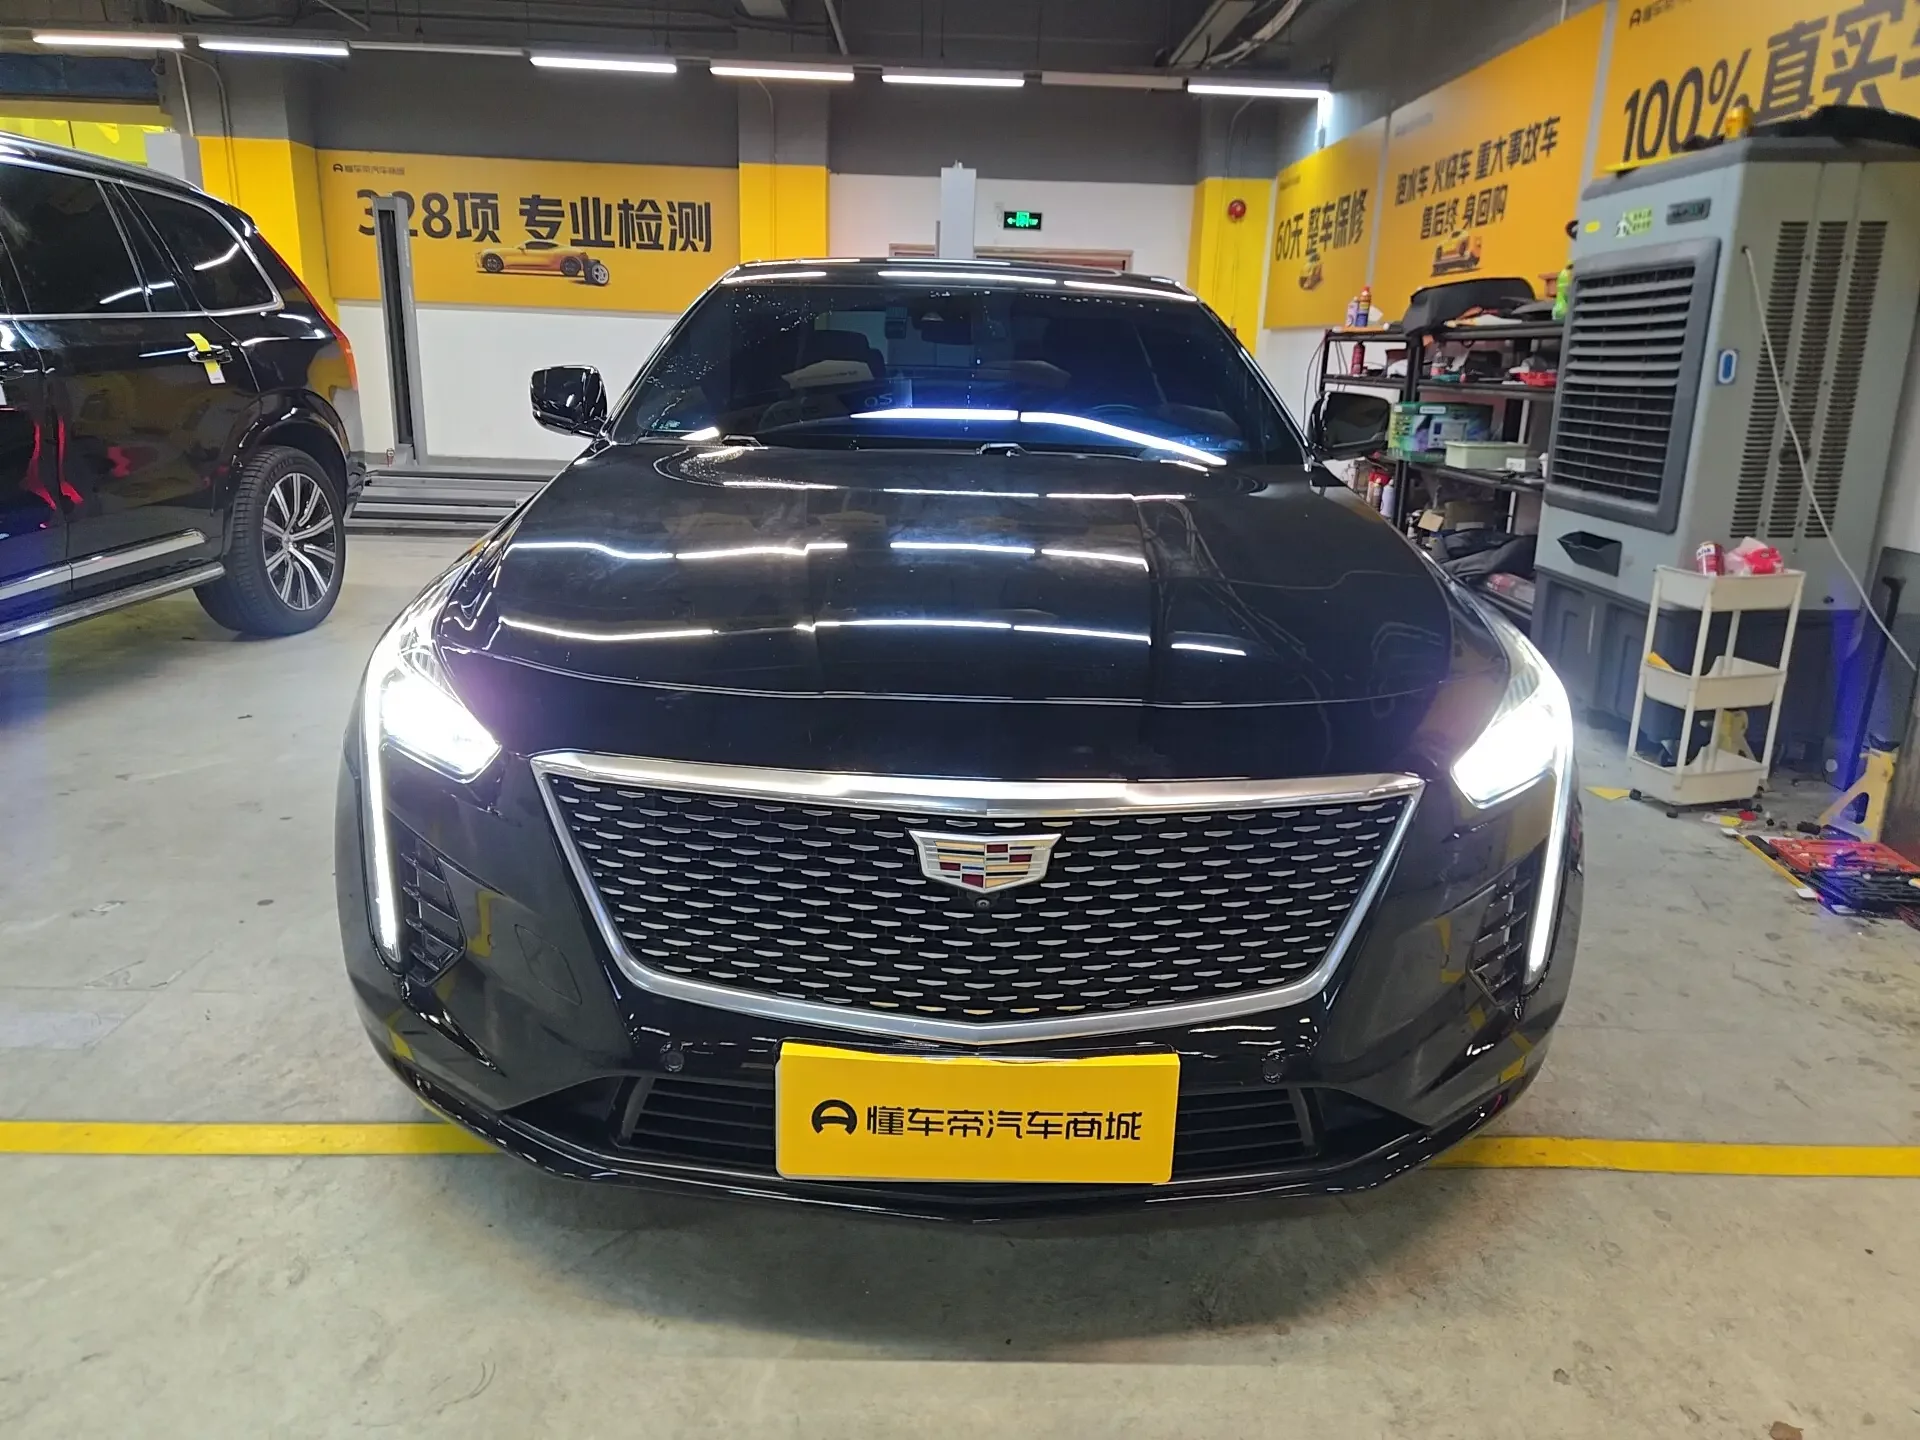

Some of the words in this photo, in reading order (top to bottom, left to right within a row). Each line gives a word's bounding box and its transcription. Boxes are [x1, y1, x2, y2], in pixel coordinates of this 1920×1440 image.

[1432, 150, 1473, 195] 火烧车
[1475, 116, 1560, 181] 重大事故车
[519, 194, 711, 252] 专业检测
[866, 1104, 1143, 1141] 懂车帝汽车商城
